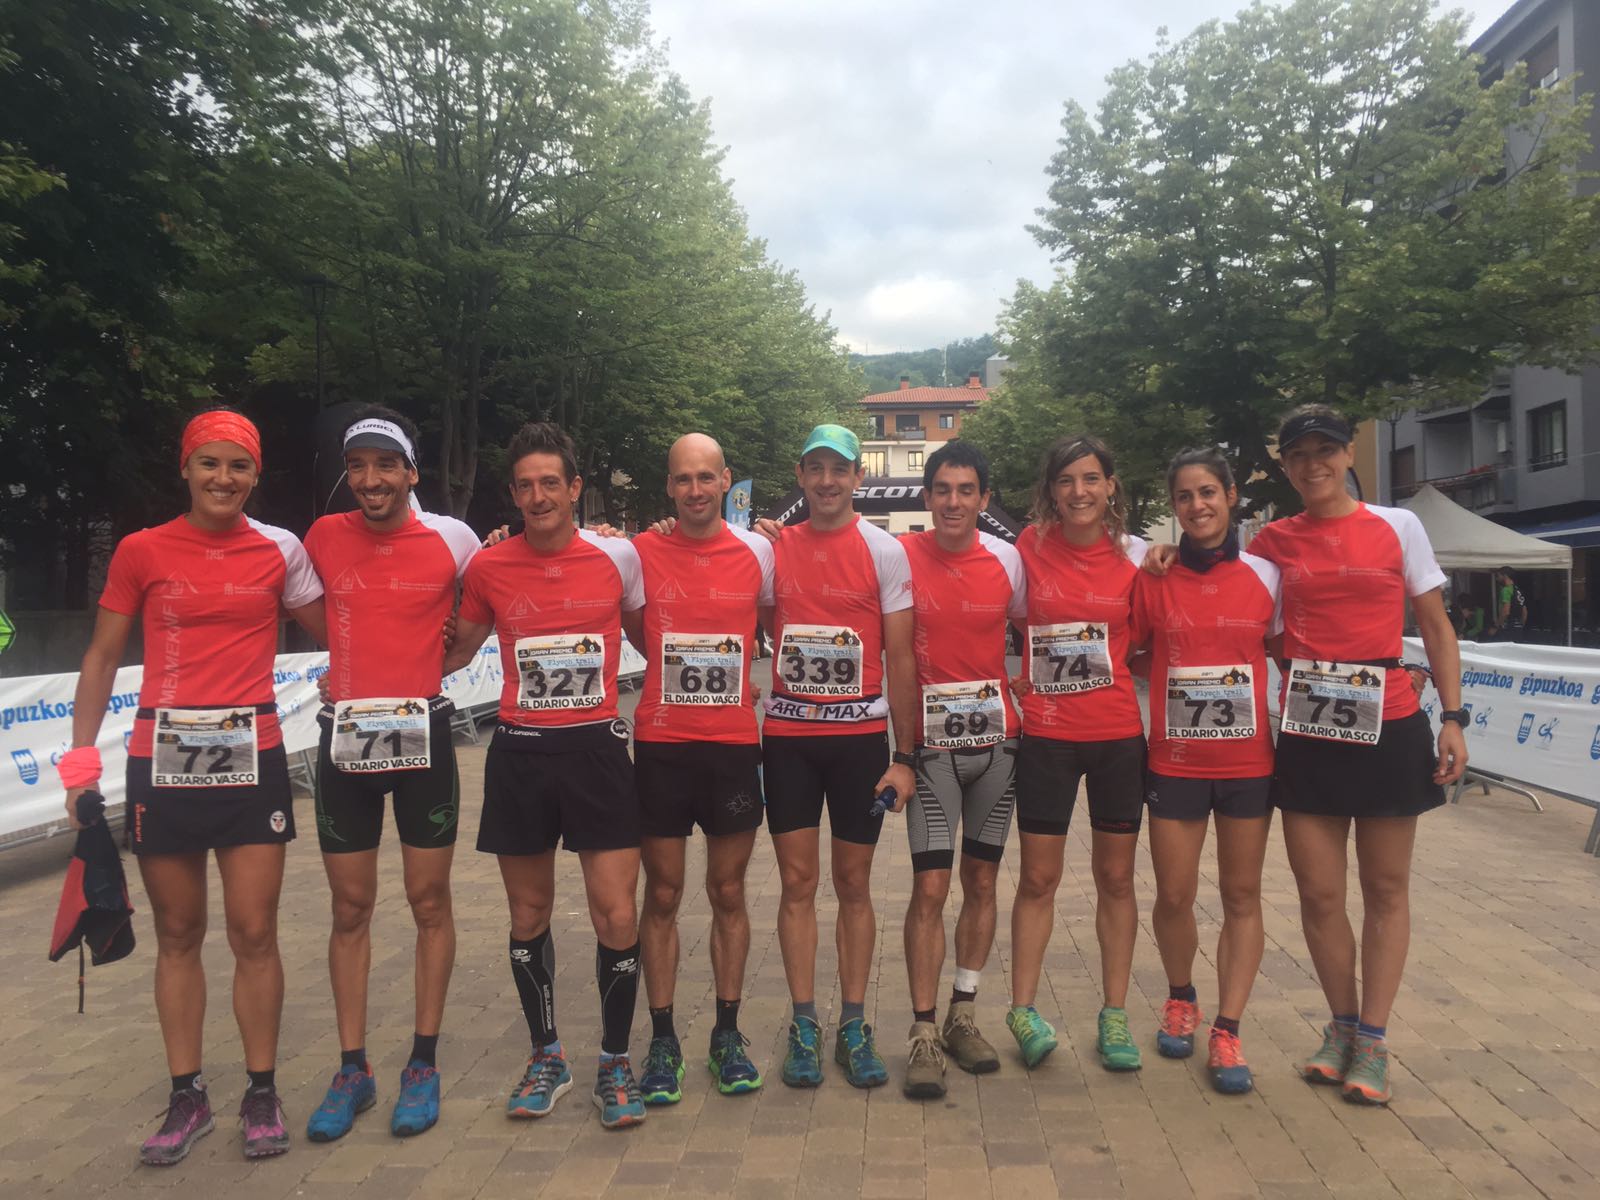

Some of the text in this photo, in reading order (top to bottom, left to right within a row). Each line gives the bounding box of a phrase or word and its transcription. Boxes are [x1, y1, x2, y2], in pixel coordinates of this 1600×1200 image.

[852, 485, 925, 499] SCOT
[979, 510, 1017, 539] COTT
[680, 665, 727, 693] 68
[785, 656, 855, 685] 339
[1049, 654, 1092, 682] 74
[527, 667, 598, 698] 327
[792, 685, 826, 694] DIARIO
[827, 686, 860, 694] VASCO
[1044, 683, 1077, 693] DIARIO
[1078, 677, 1112, 690] VASCO
[1460, 667, 1513, 689] gipuzkoa
[1519, 673, 1584, 698] gipuzkoa
[520, 696, 604, 709] EL DIARIO VASCO
[664, 694, 740, 704] EL DIARIO VASCO
[1184, 698, 1235, 727] 73
[1307, 695, 1358, 728] 75
[944, 711, 988, 738] 69
[1168, 728, 1255, 738] EL DIARIO VASCO
[1285, 722, 1377, 743] EL DIARIO VASCO
[356, 731, 402, 760] 71
[939, 738, 973, 748] DIARIO
[974, 734, 1004, 745] VASCO
[177, 744, 233, 774] 72
[336, 757, 428, 771] EL DIARIO VASCO
[156, 773, 255, 785] EL DIARIO VASCO
[542, 984, 553, 1030] BOOSTER
